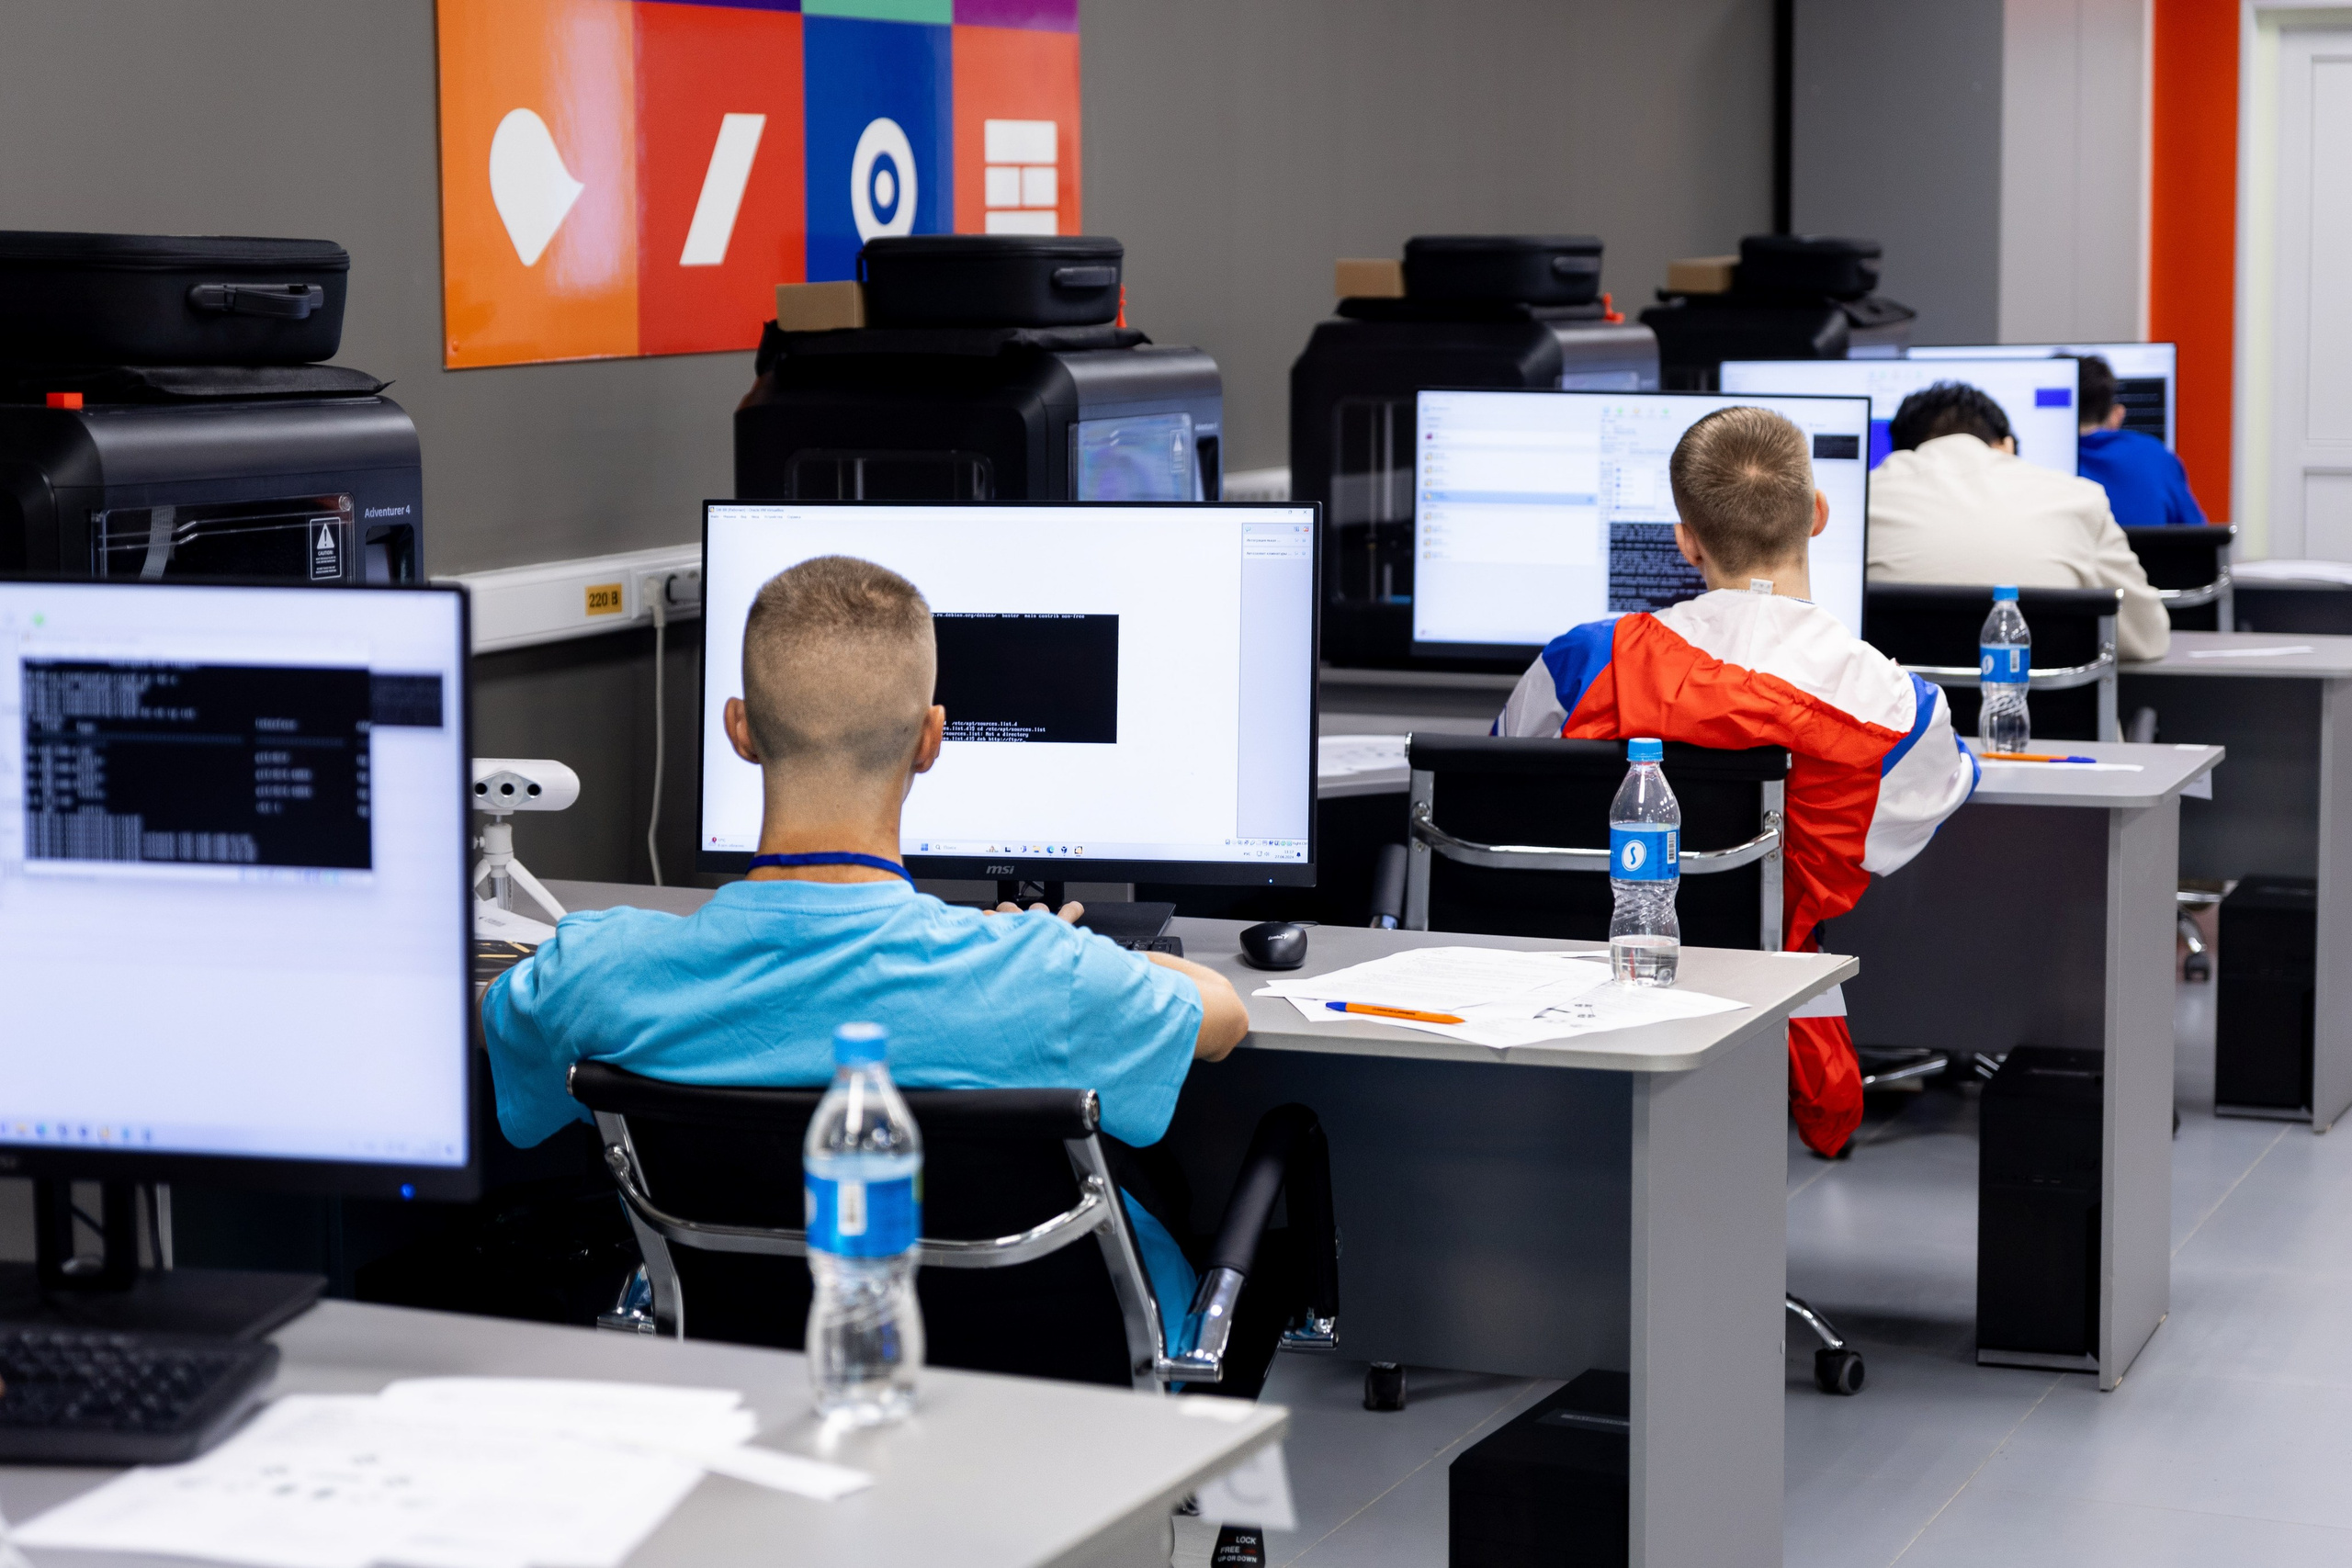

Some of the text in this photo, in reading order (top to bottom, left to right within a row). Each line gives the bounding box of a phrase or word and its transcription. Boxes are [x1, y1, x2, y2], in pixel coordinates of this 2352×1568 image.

[365, 504, 411, 518] Adventurer 4
[589, 592, 608, 608] 220
[986, 865, 1014, 874] msi
[1236, 1536, 1256, 1545] LOCK
[1237, 1555, 1257, 1563] DOWN
